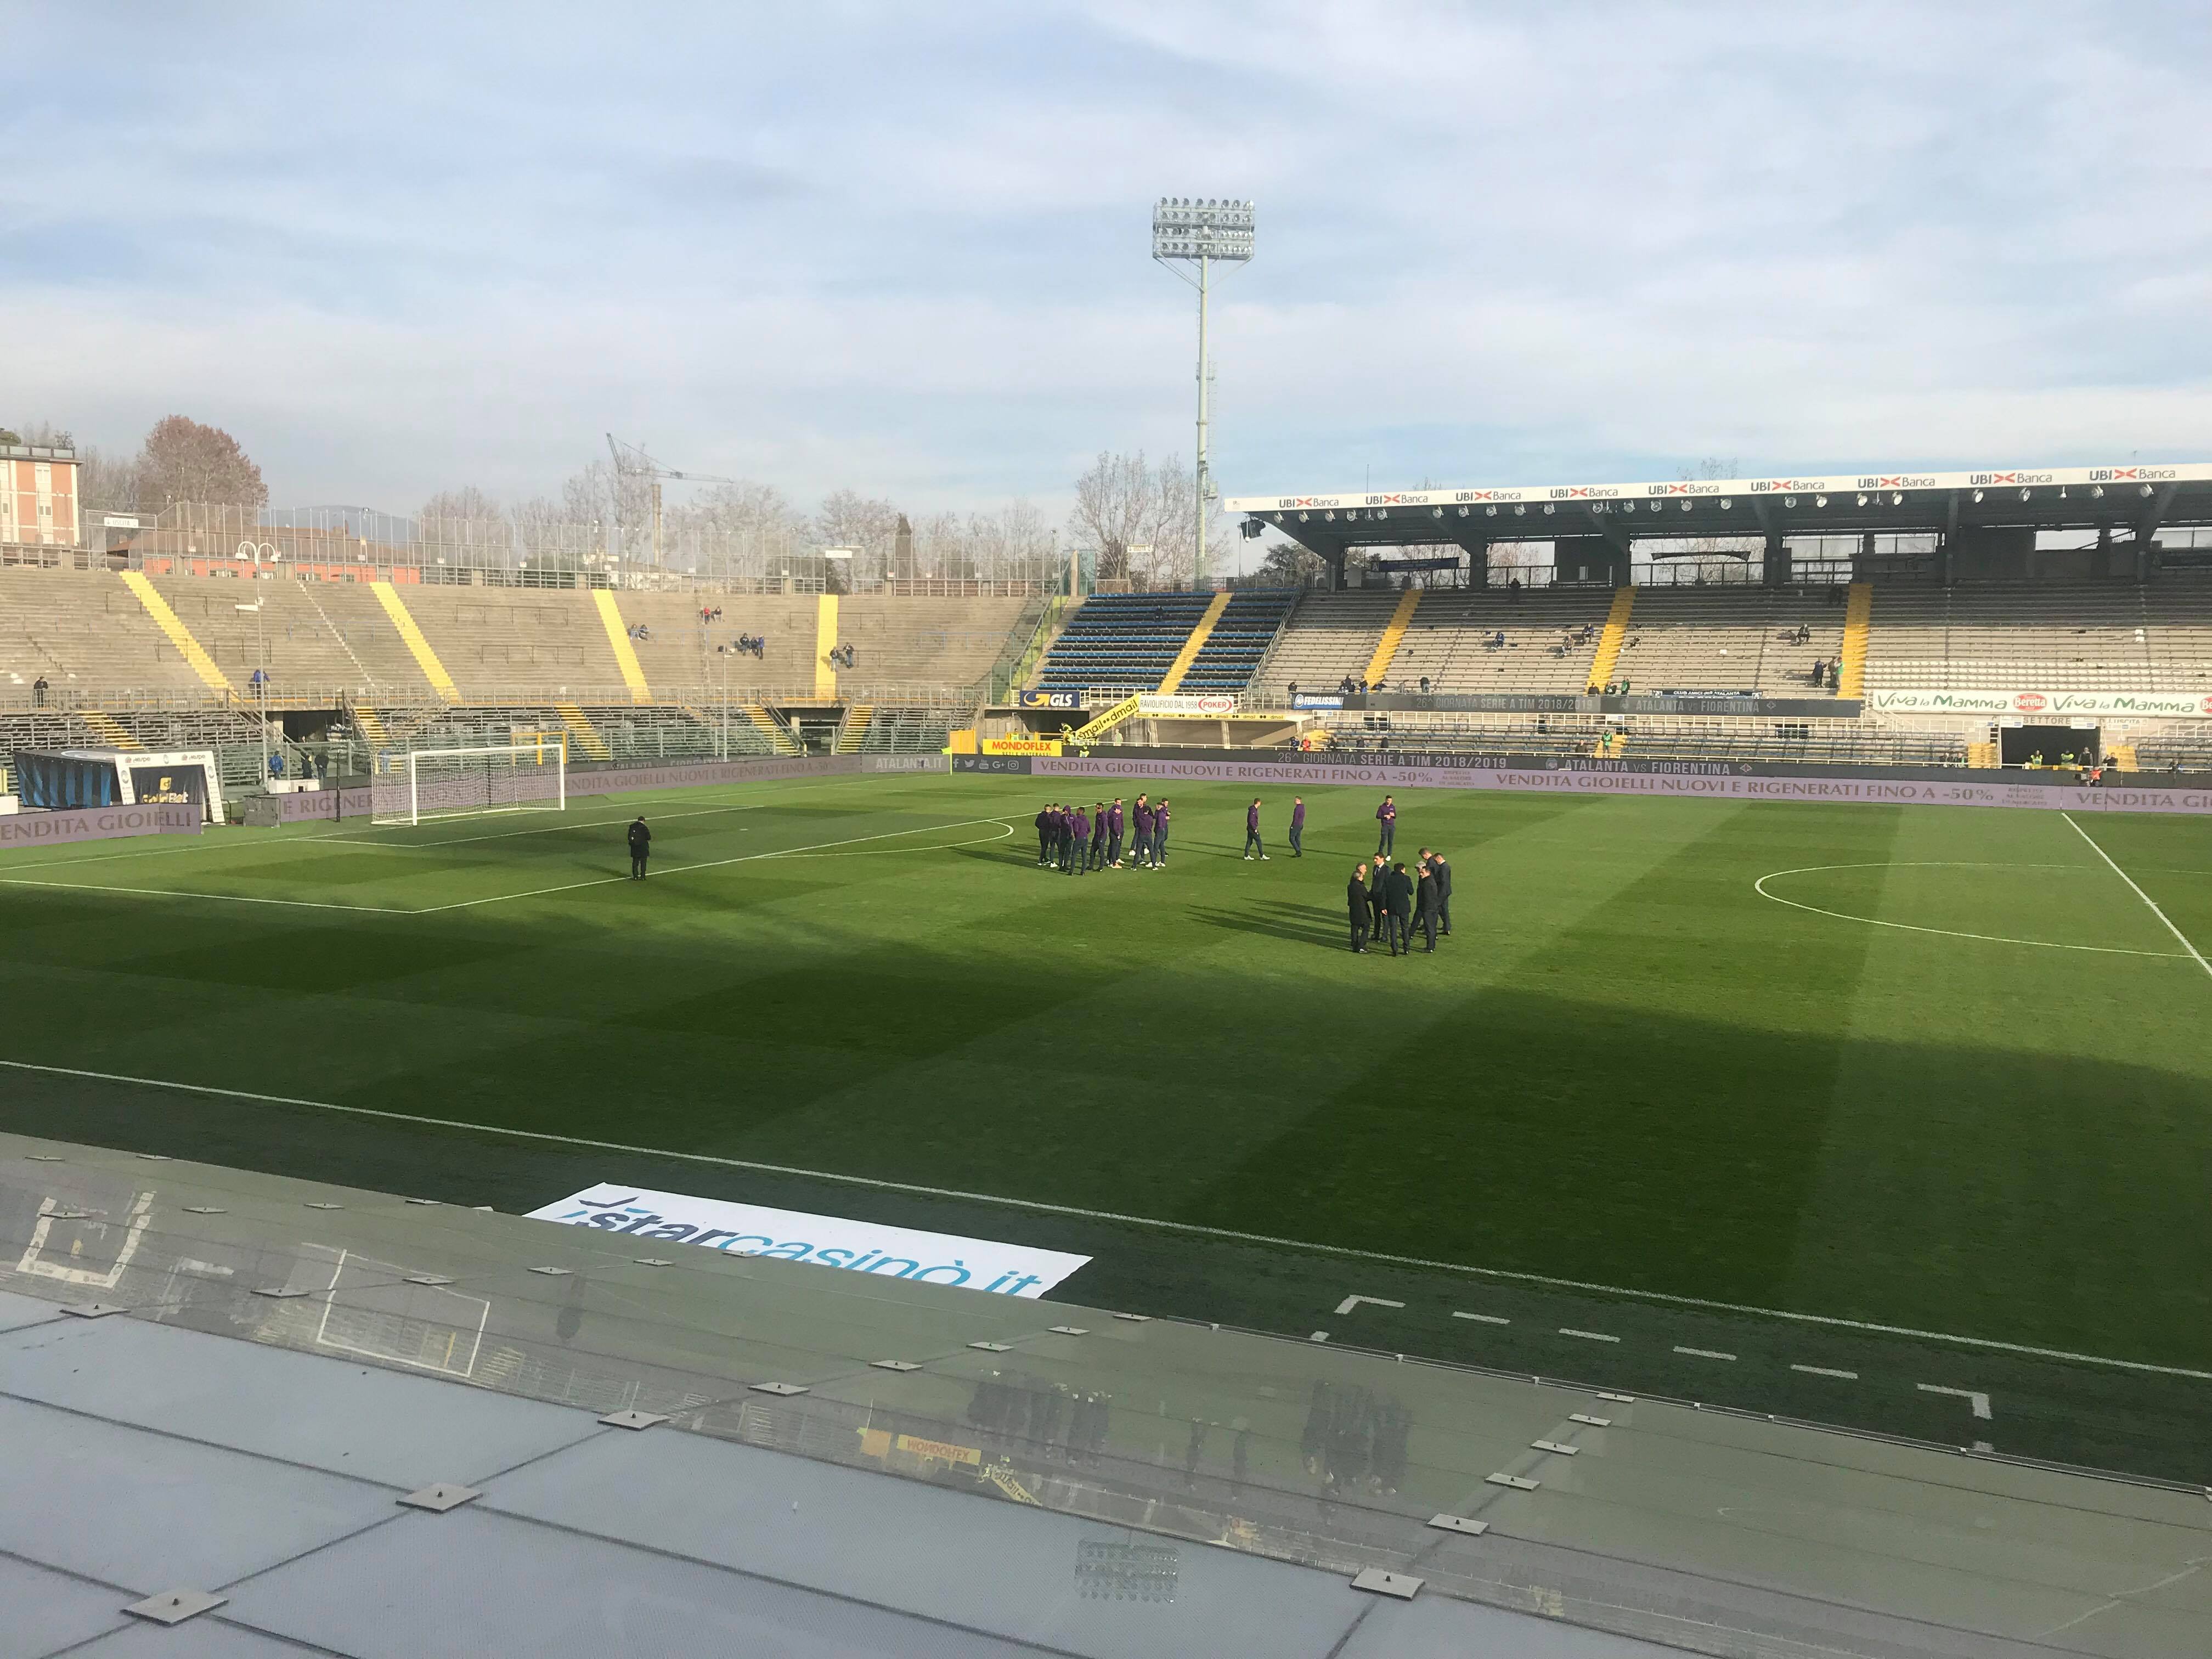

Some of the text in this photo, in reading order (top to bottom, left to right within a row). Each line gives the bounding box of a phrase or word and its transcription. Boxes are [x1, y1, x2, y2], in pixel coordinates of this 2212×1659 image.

[1970, 473, 2052, 484] UBI Banca
[2089, 469, 2176, 481] UBI Banca
[1751, 481, 1825, 492] UBI Banca
[1858, 477, 1936, 488] UBI Banca
[1550, 488, 1618, 498] UBI Banca
[1648, 484, 1719, 494] UBI Banca
[1365, 495, 1428, 505] UBI Banca
[1455, 491, 1521, 501] UBI Banca
[1279, 498, 1339, 508] UBI Banca
[1050, 693, 1073, 707] GLS
[1140, 699, 1198, 709] RAVIOLIFICIO DAL 1958
[1436, 698, 1477, 709] GIORNATA
[1481, 698, 1506, 709] SERIE
[1510, 698, 1516, 709] A
[1519, 698, 1535, 709] TIM
[1538, 699, 1593, 710] 2018/2019
[1878, 692, 1917, 708] Viva
[1933, 695, 2007, 710] Mamma
[2015, 697, 2046, 707] Beretta
[2053, 695, 2195, 713] Viva la Mamma
[1110, 699, 1138, 721] dmail
[1635, 700, 1684, 711] ATALANTA
[1701, 701, 1760, 713] FIORENTINA
[2023, 716, 2070, 725] SETTORE
[992, 741, 1052, 752] MONDOFLEX
[876, 757, 944, 769] ATALANTA.IT
[1303, 753, 1356, 765] GIORNATA
[1361, 754, 1393, 766] SERIE
[1398, 755, 1405, 766] A
[1409, 755, 1431, 766] TIM
[1435, 756, 1507, 768] 2018/2019
[1040, 761, 1432, 782] VENDITA GIOIELLI NUOVI E RIGENERATI FINO A -50%
[1565, 759, 1730, 775] ATALANTA VS FIORENTINA
[566, 776, 611, 791] ENDITA
[614, 773, 665, 787] GIOIELLI
[669, 770, 709, 783] NUOVI
[1496, 774, 1994, 801] VENDITA GIOIELLI NUOVI E RIGENERATI FINO A -50%
[2076, 792, 2212, 808] VENDITA GI
[283, 800, 293, 815] E
[1, 811, 191, 840] ENDITA GIOIELLI
[580, 1212, 1043, 1295] starcasinòit
